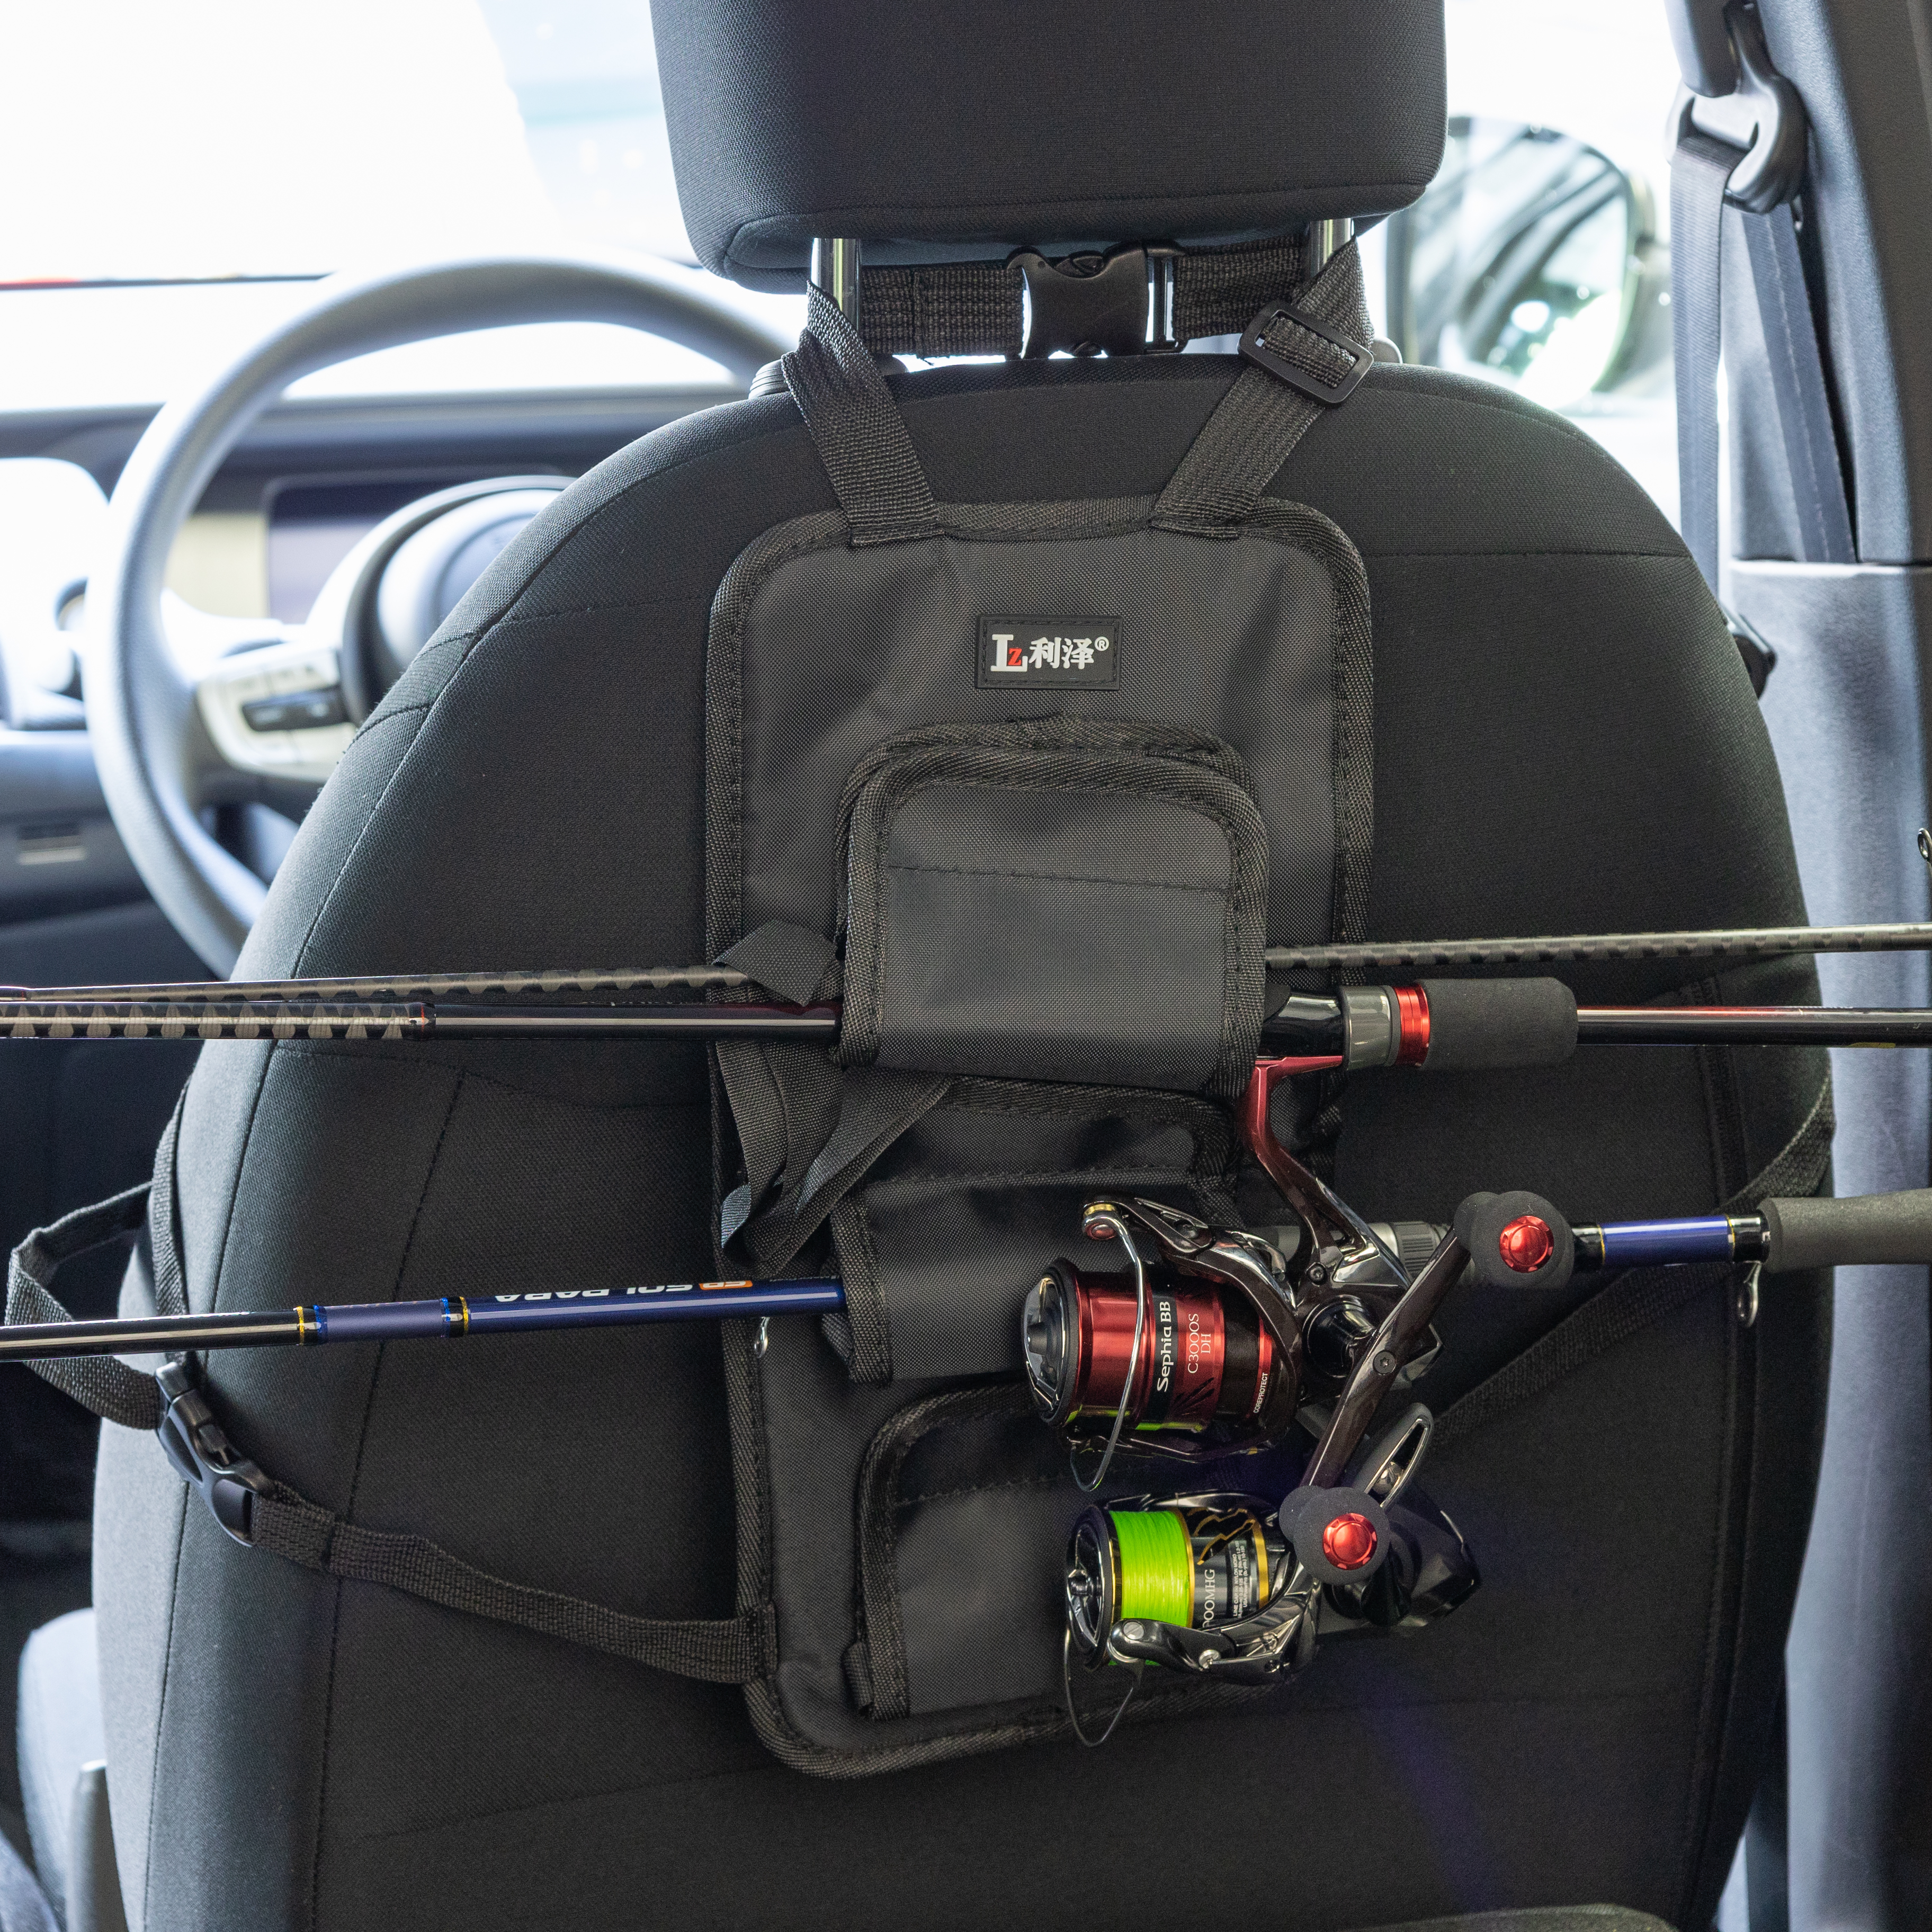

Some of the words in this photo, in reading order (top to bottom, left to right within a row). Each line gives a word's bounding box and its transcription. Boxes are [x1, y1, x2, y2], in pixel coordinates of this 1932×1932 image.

[1159, 1301, 1171, 1322] BB
[1157, 1326, 1174, 1392] Sephia
[1187, 1313, 1200, 1374] C3000S
[1201, 1333, 1211, 1354] DH
[1253, 1372, 1268, 1414] COREPROTECT
